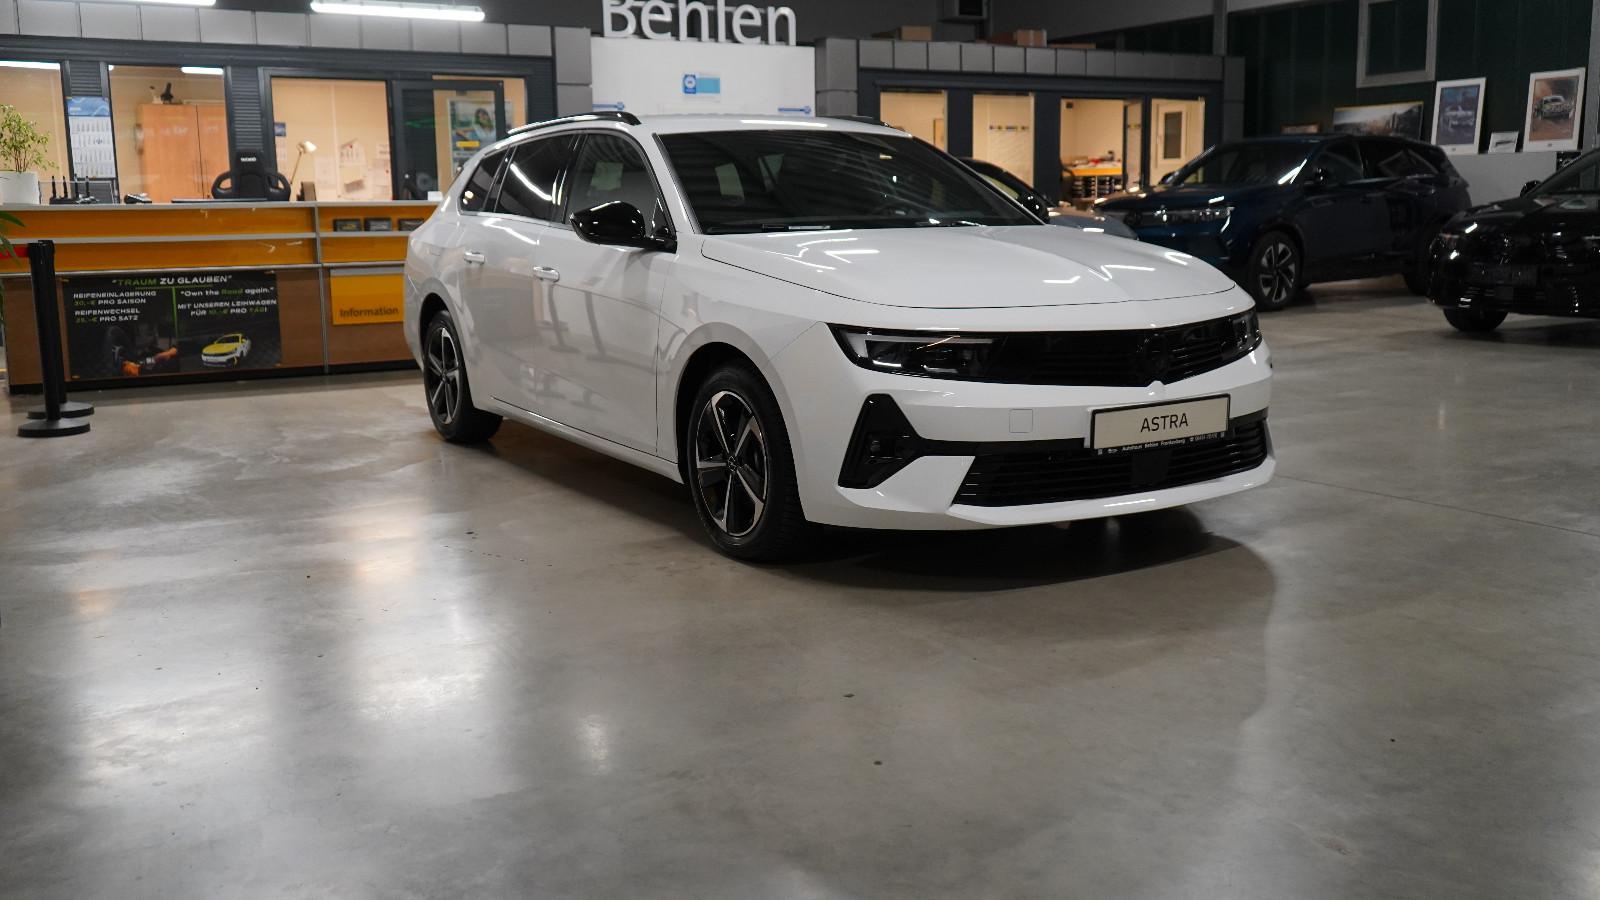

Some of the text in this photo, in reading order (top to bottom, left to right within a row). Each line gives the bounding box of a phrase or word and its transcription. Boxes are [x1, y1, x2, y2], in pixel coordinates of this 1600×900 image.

[603, 0, 797, 46] Behlen
[160, 277, 175, 285] ZU
[178, 275, 232, 284] GLAUBEN"
[73, 291, 157, 299] REIFENEINLAGERUNG
[205, 288, 219, 296] the
[232, 300, 277, 308] LEIHWAGEN
[75, 308, 140, 316] REIFENWECHSEL
[340, 306, 399, 318] Information
[1140, 412, 1189, 433] ASTRA
